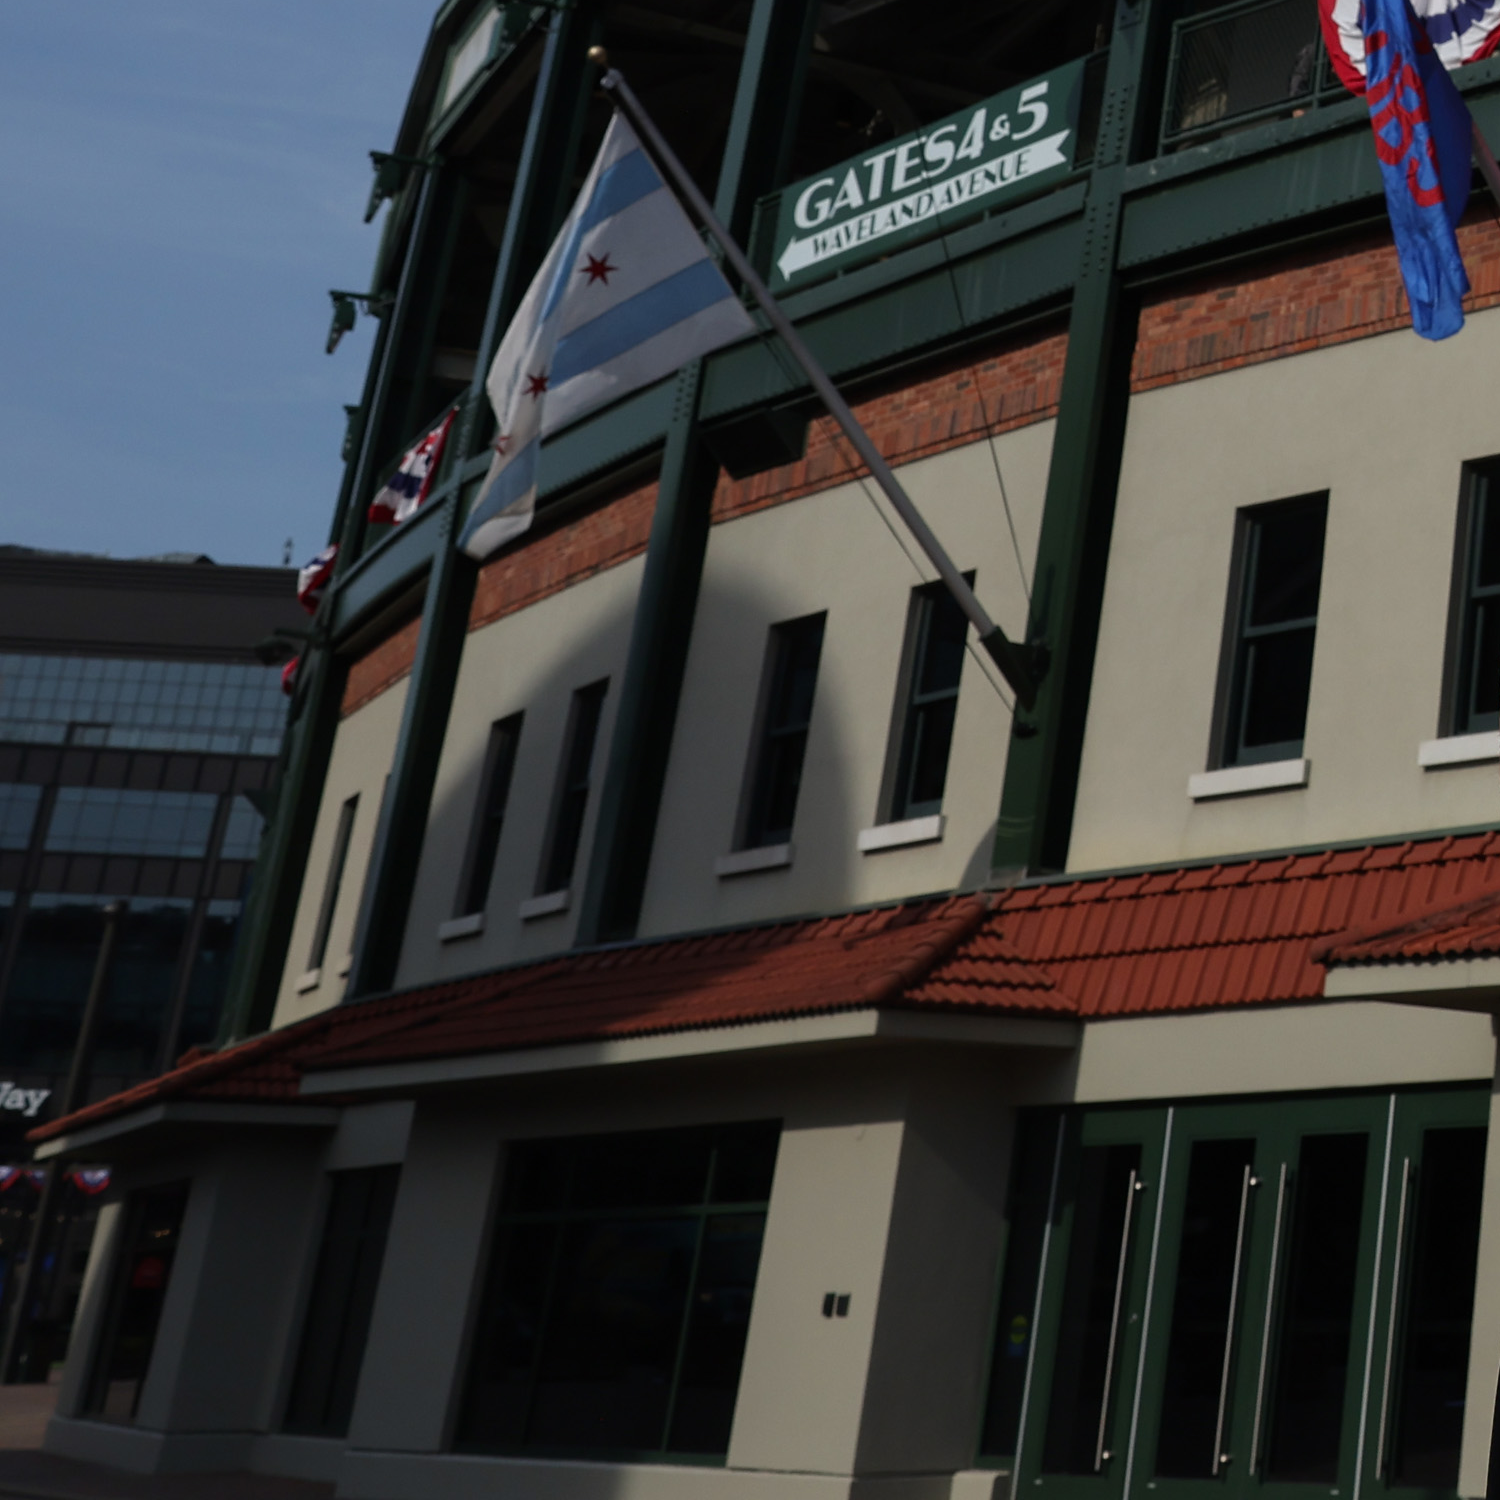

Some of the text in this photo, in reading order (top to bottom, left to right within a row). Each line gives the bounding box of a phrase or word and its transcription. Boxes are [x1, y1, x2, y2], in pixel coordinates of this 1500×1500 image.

[793, 80, 1050, 229] GATES 4 & 5
[812, 150, 1030, 257] WAVELAND AVENUE
